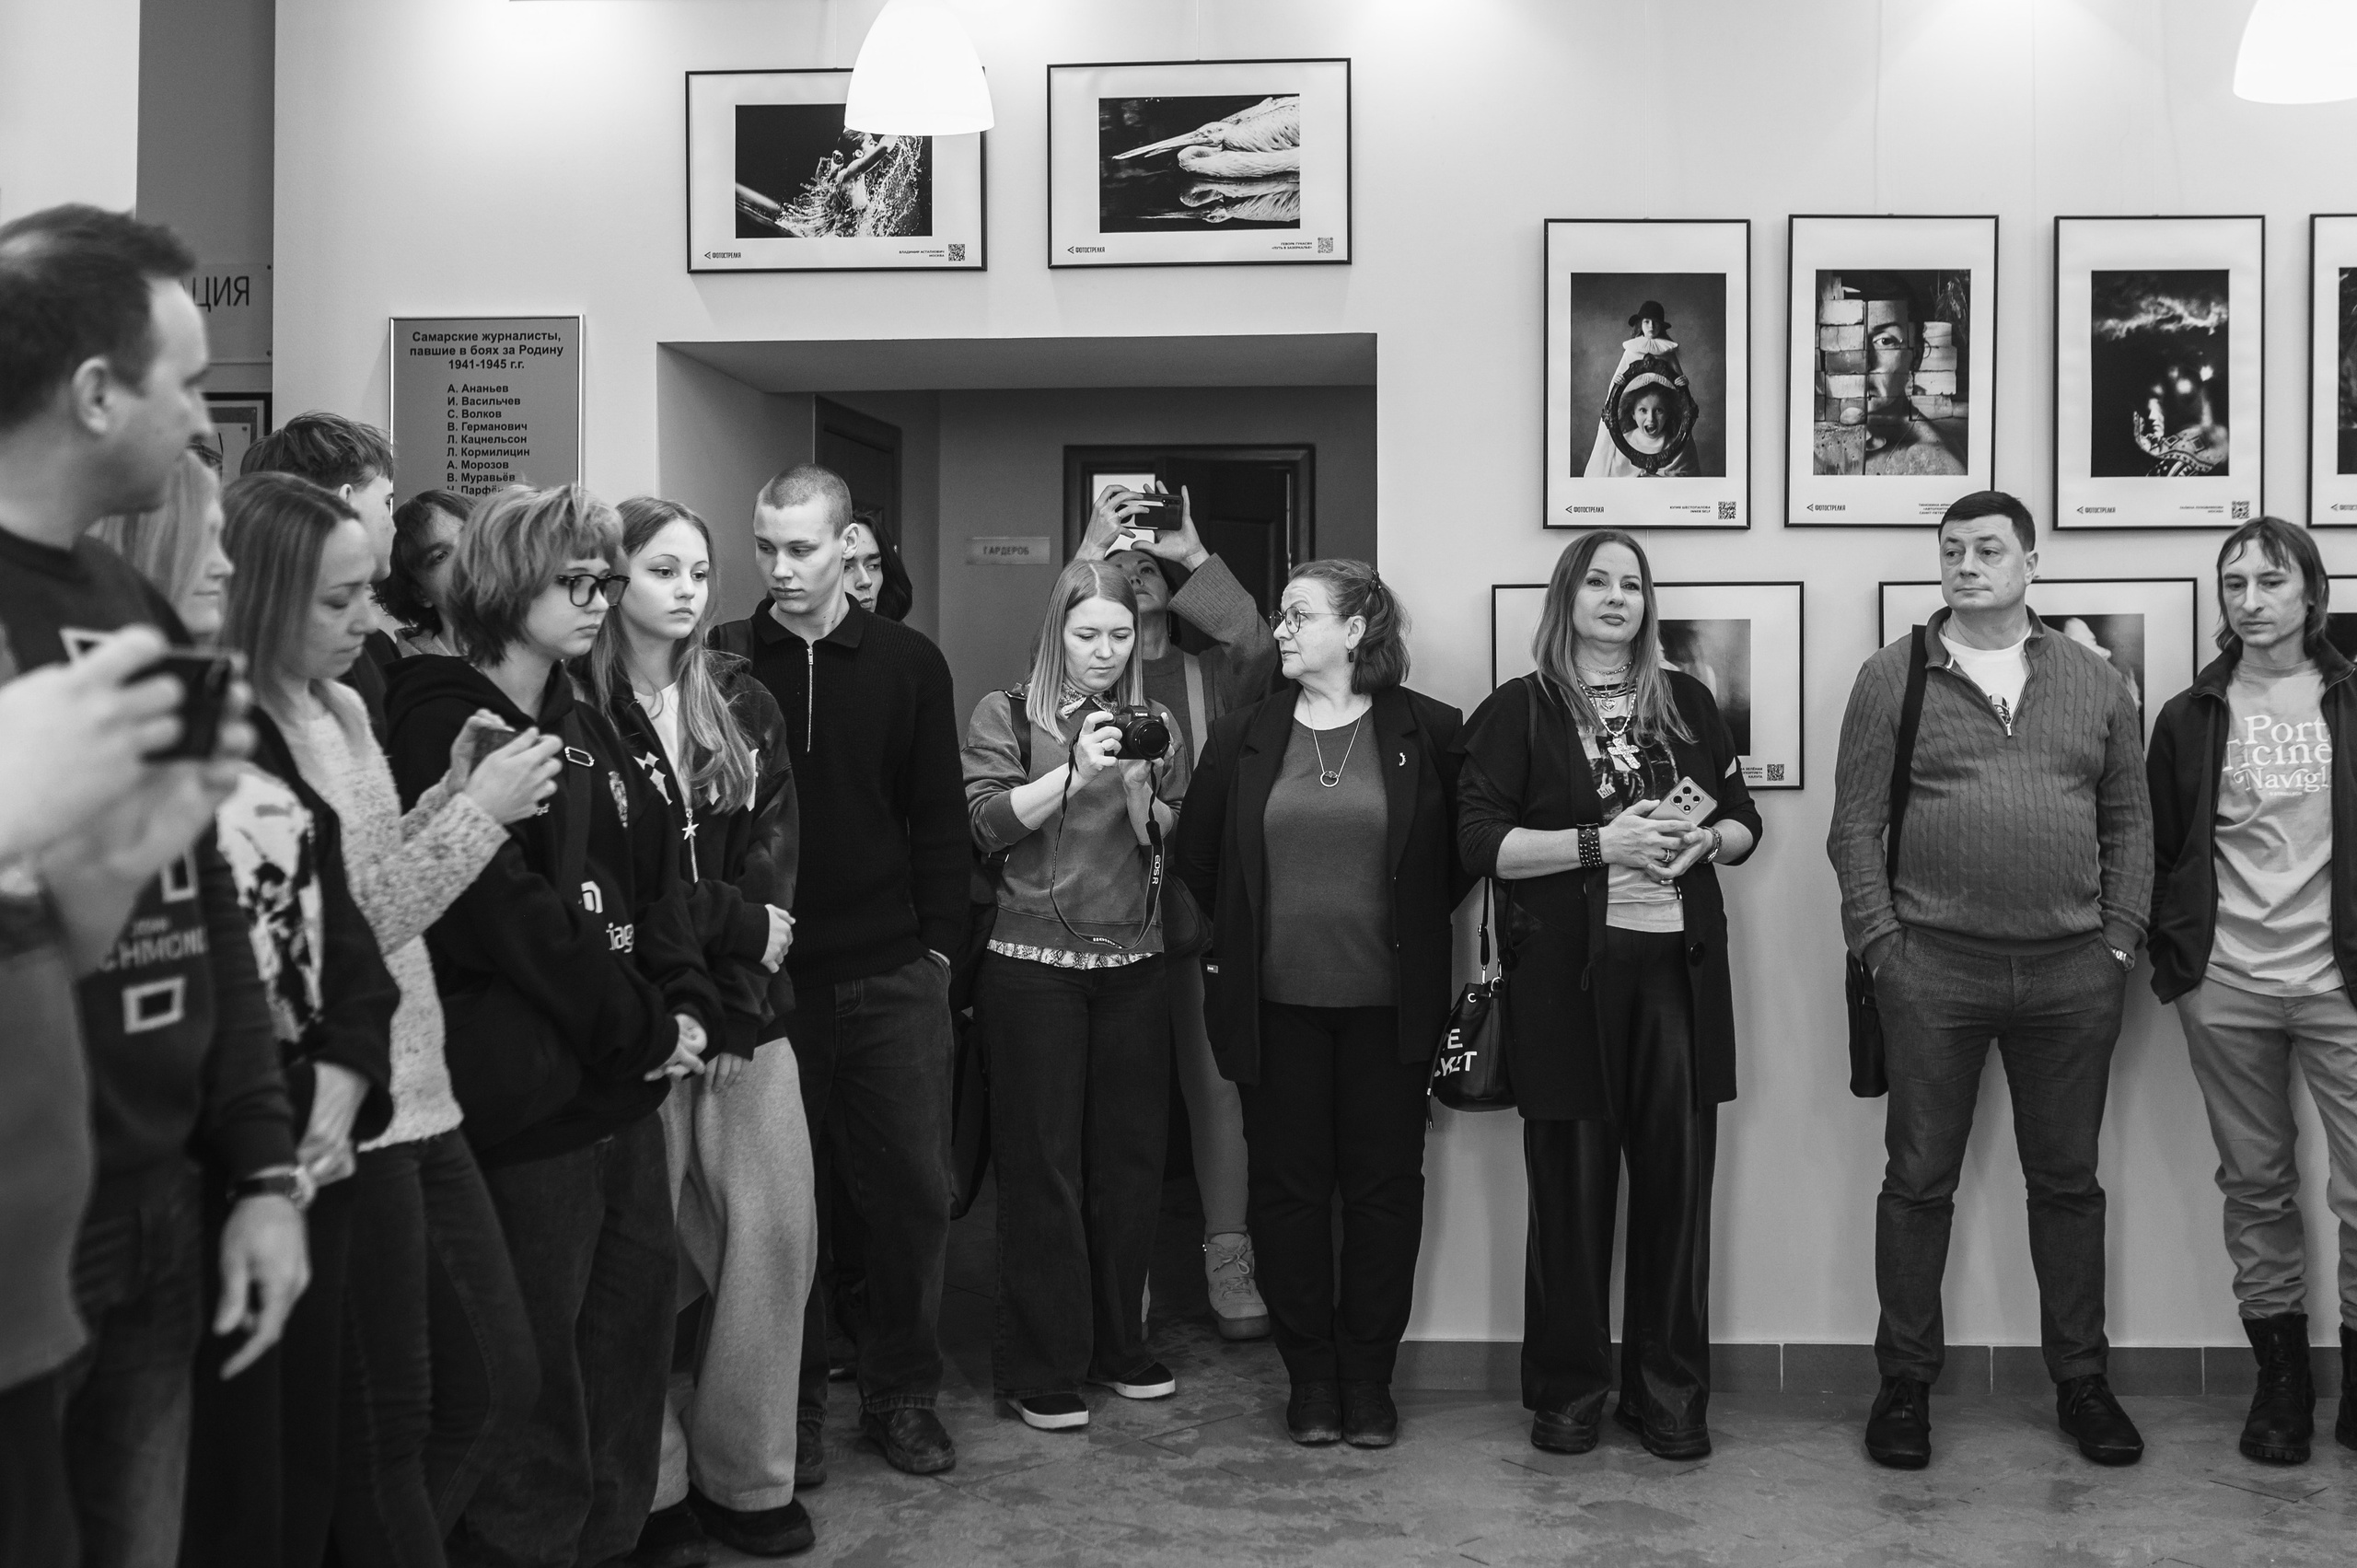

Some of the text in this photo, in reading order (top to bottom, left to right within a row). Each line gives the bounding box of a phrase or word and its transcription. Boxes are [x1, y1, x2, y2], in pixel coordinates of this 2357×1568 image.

[1074, 246, 1106, 254] ФОТОСТРЕЛКА
[192, 275, 250, 313] ЦИЯ
[412, 331, 562, 343] Самарские журналисты,
[410, 347, 457, 356] павшие
[470, 344, 499, 355] боях
[502, 347, 516, 355] за
[518, 344, 564, 357] Родину
[448, 359, 525, 369] 1941-1945 г.г.
[447, 383, 509, 393] А. Ананьев
[447, 396, 521, 406] И. Васильчев
[447, 409, 502, 419] С. Волков
[447, 422, 528, 434] В. Германович
[447, 435, 528, 446] Л. Кацнельсон
[447, 447, 530, 459] Л. Кормилицин
[447, 460, 509, 471] А. Морозов
[447, 471, 516, 484] В. Муравьёв
[1573, 505, 1605, 514] ФОТОСТРЕЛКА
[1814, 504, 1846, 512] ФОТОСТРЕЛКА
[2244, 714, 2331, 745] Port
[2233, 765, 2332, 793] Navigl
[1152, 854, 1162, 885] EOS R
